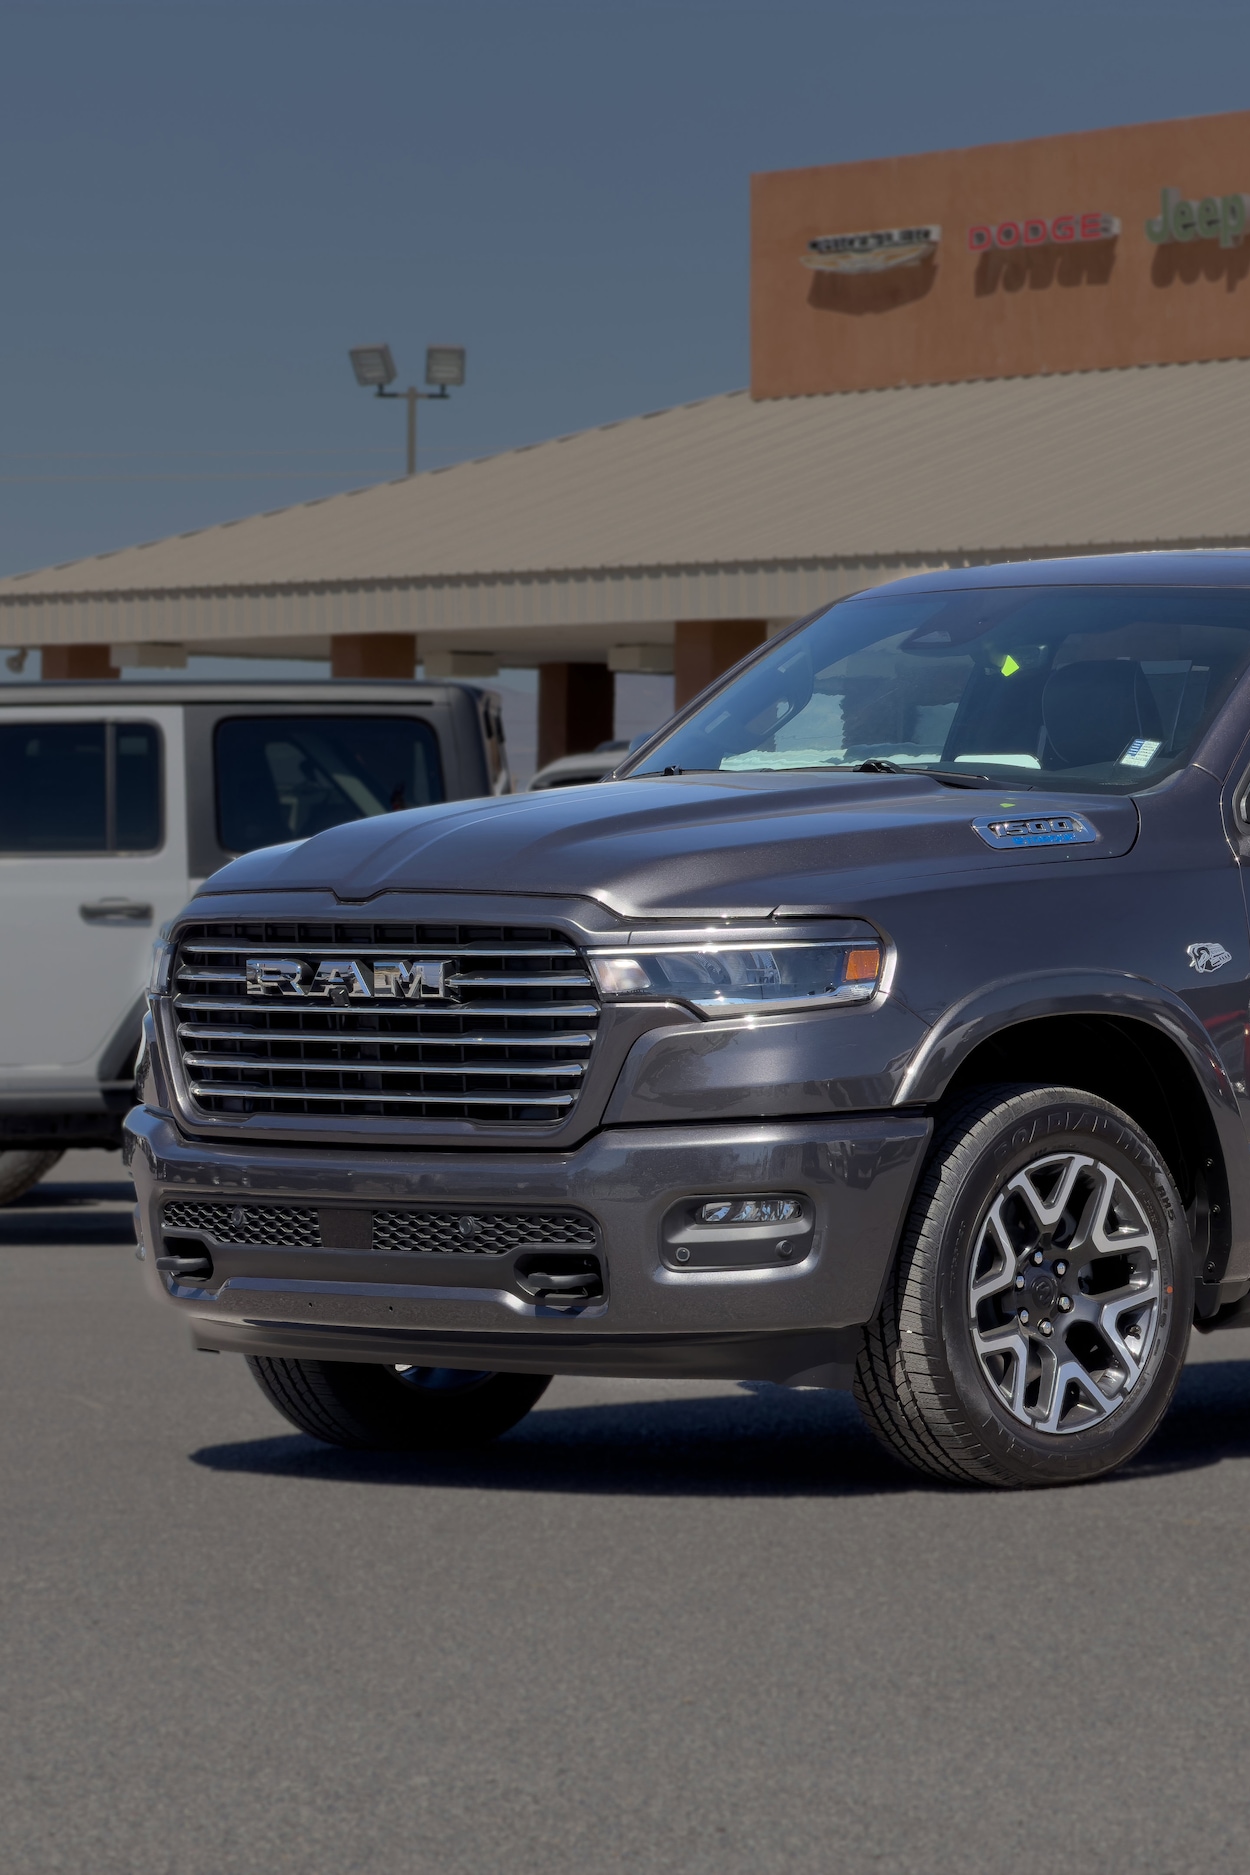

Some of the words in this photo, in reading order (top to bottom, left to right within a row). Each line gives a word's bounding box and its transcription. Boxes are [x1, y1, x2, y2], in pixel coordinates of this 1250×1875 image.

[967, 212, 1104, 251] DODGE
[1144, 186, 1249, 248] Jeep
[990, 820, 1075, 837] 1500
[246, 959, 447, 998] RAM
